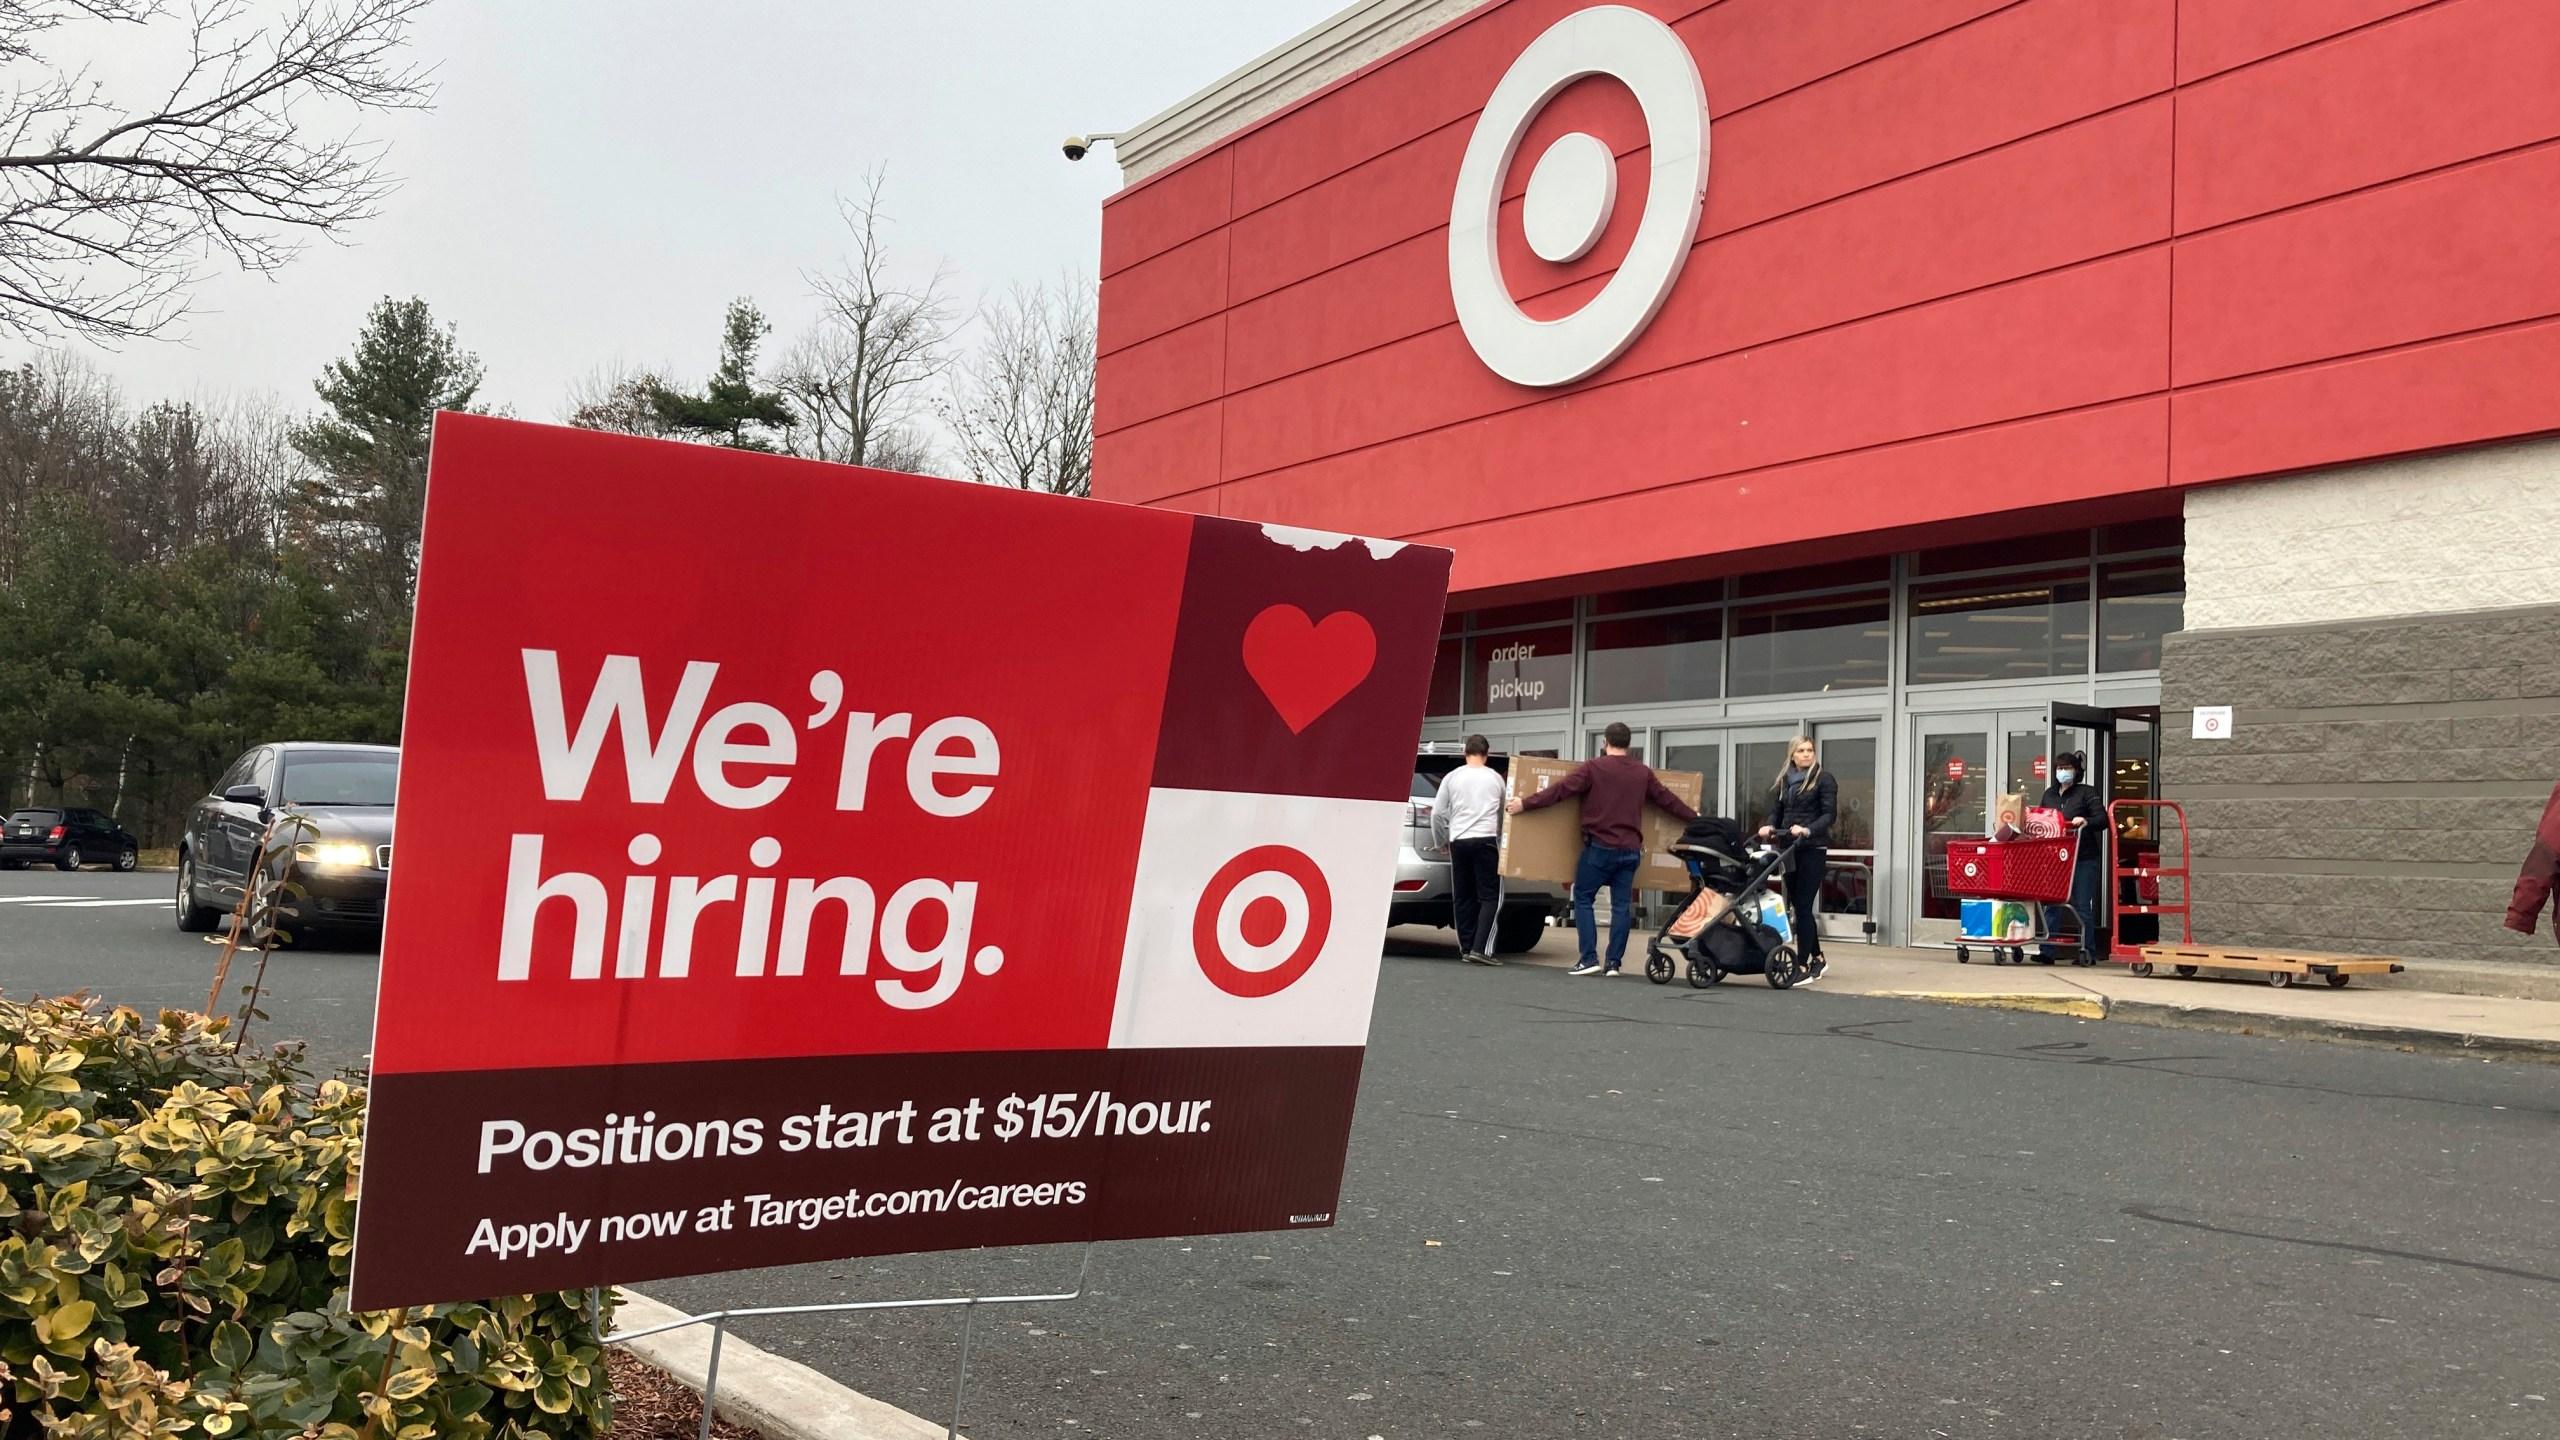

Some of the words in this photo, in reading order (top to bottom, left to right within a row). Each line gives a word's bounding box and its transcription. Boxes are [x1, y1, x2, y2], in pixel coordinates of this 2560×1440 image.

[1490, 677, 1545, 703] pickup
[1491, 641, 1536, 663] order
[521, 648, 1001, 818] We're
[497, 833, 1005, 1010] hiring.
[477, 1110, 764, 1174] Positions
[778, 1100, 918, 1152] start
[927, 1097, 985, 1143] at
[993, 1090, 1212, 1143] $15/hour.
[464, 1211, 592, 1261] Apply
[599, 1209, 688, 1243] now
[694, 1199, 736, 1233] at
[743, 1179, 1088, 1232] Target.com/careers
